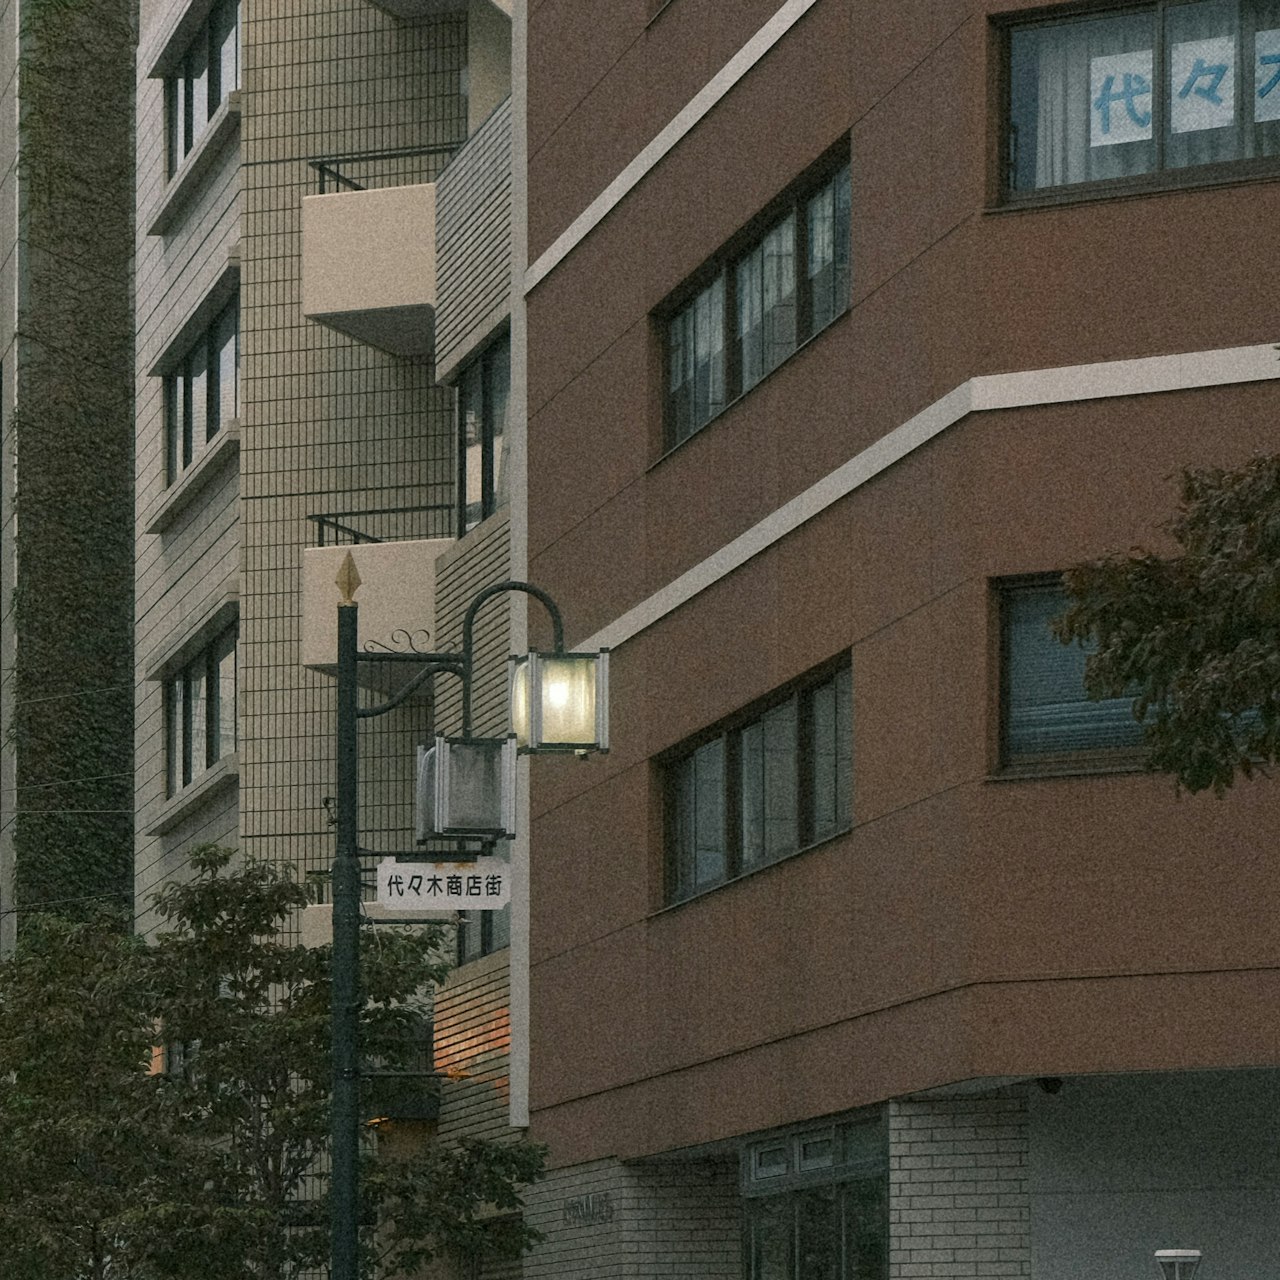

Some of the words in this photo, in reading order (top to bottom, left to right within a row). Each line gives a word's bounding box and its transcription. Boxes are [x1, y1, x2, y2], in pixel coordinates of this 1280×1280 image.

[387, 874, 502, 897] 代々木商店街
